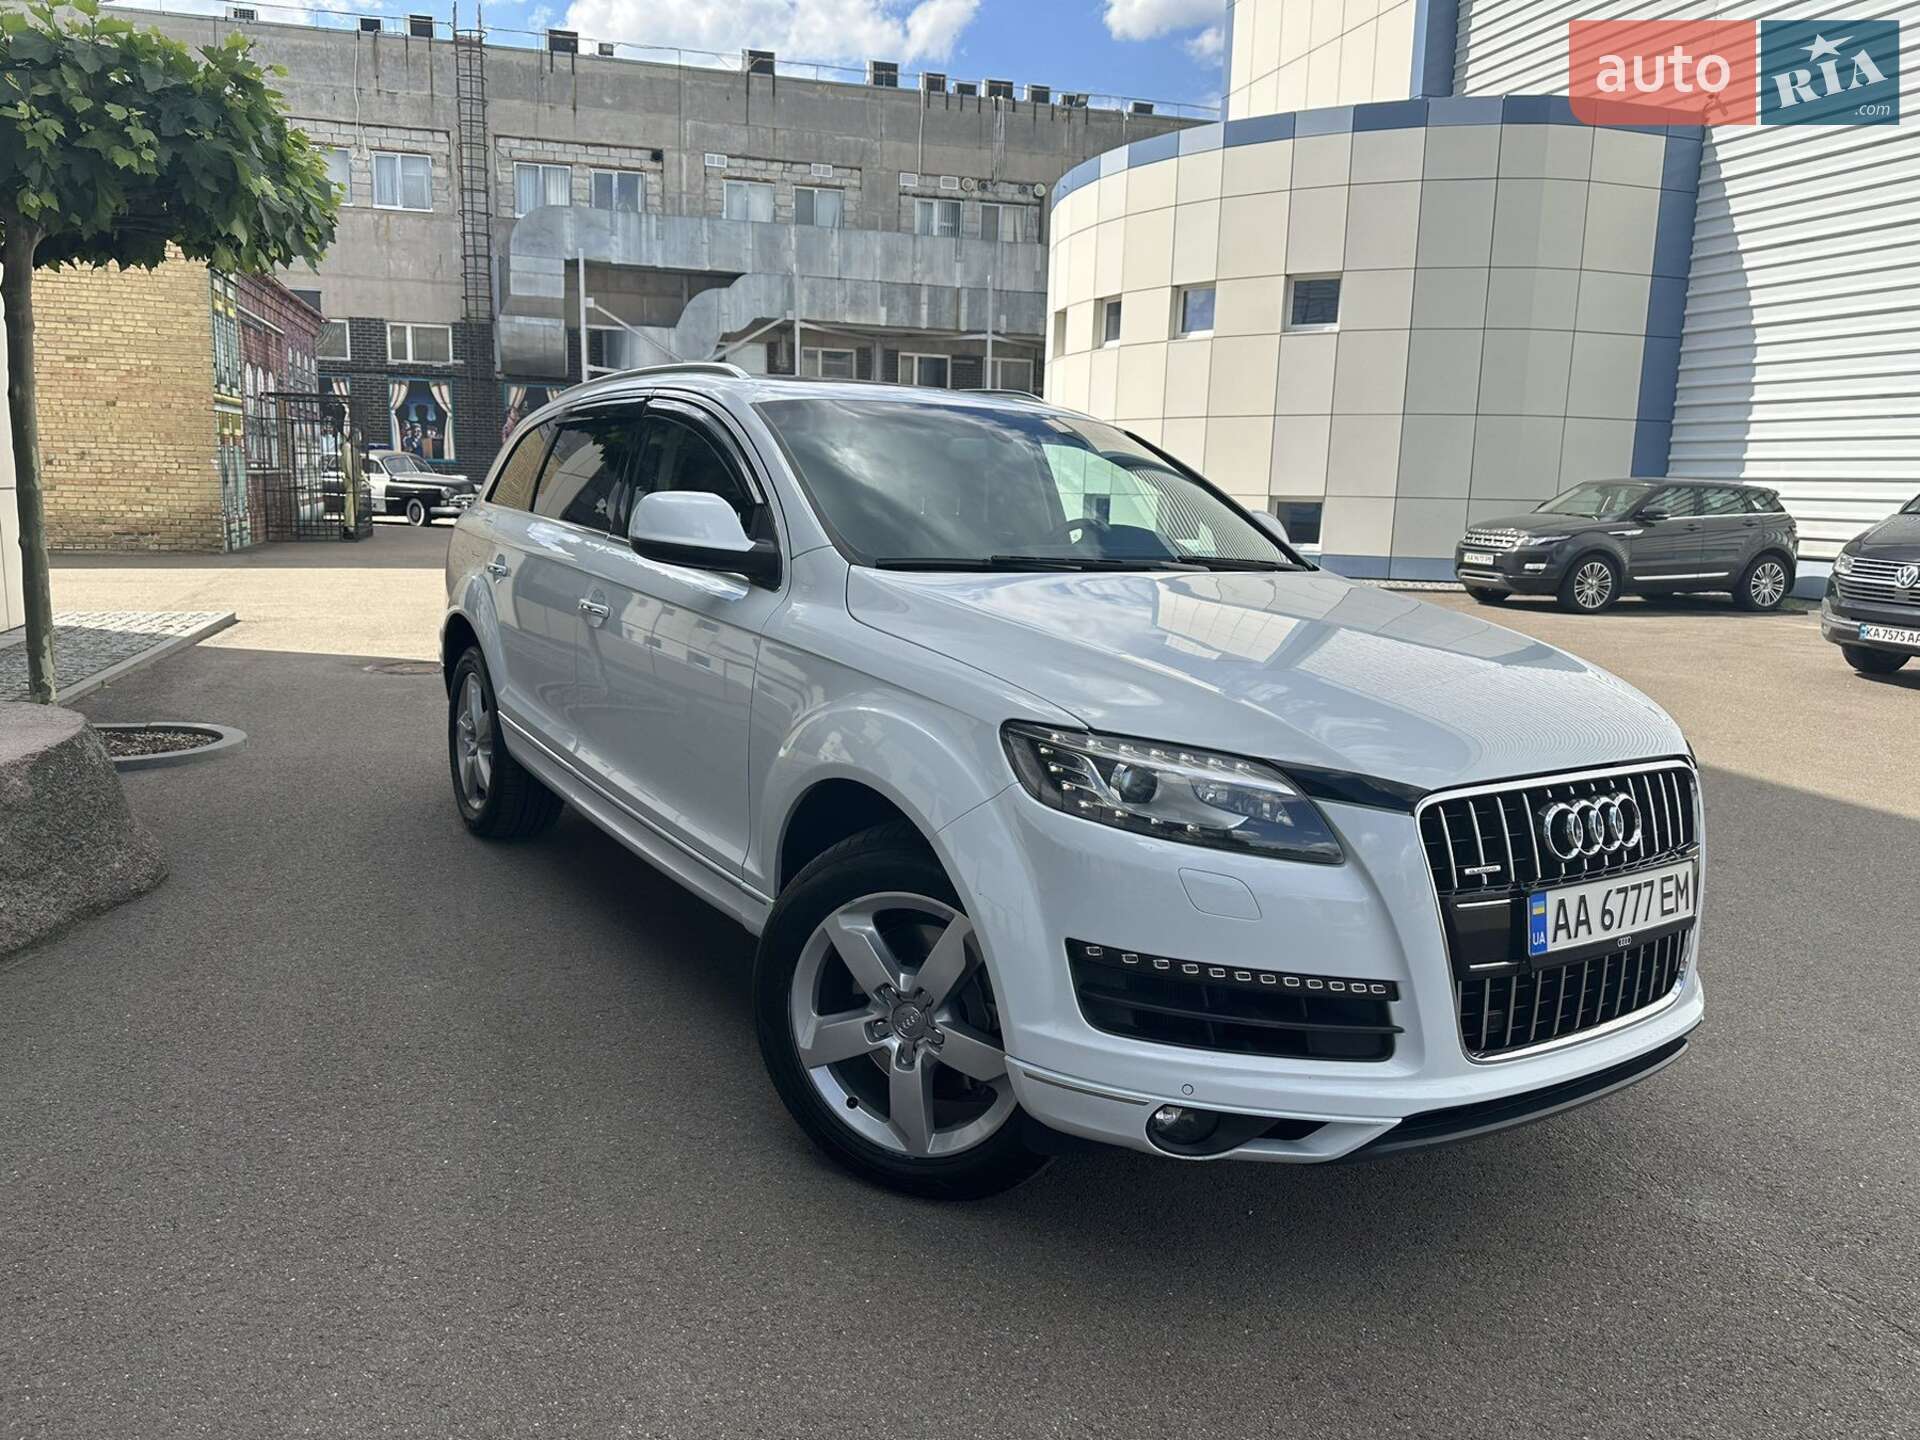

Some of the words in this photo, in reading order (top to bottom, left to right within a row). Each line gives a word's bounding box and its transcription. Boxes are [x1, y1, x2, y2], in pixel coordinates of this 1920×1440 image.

[1866, 627, 1880, 639] KA
[1882, 629, 1906, 642] 7575
[1552, 893, 1593, 944] AA
[1600, 879, 1654, 932] 6777
[1660, 871, 1690, 917] EM
[1532, 931, 1546, 946] UA
